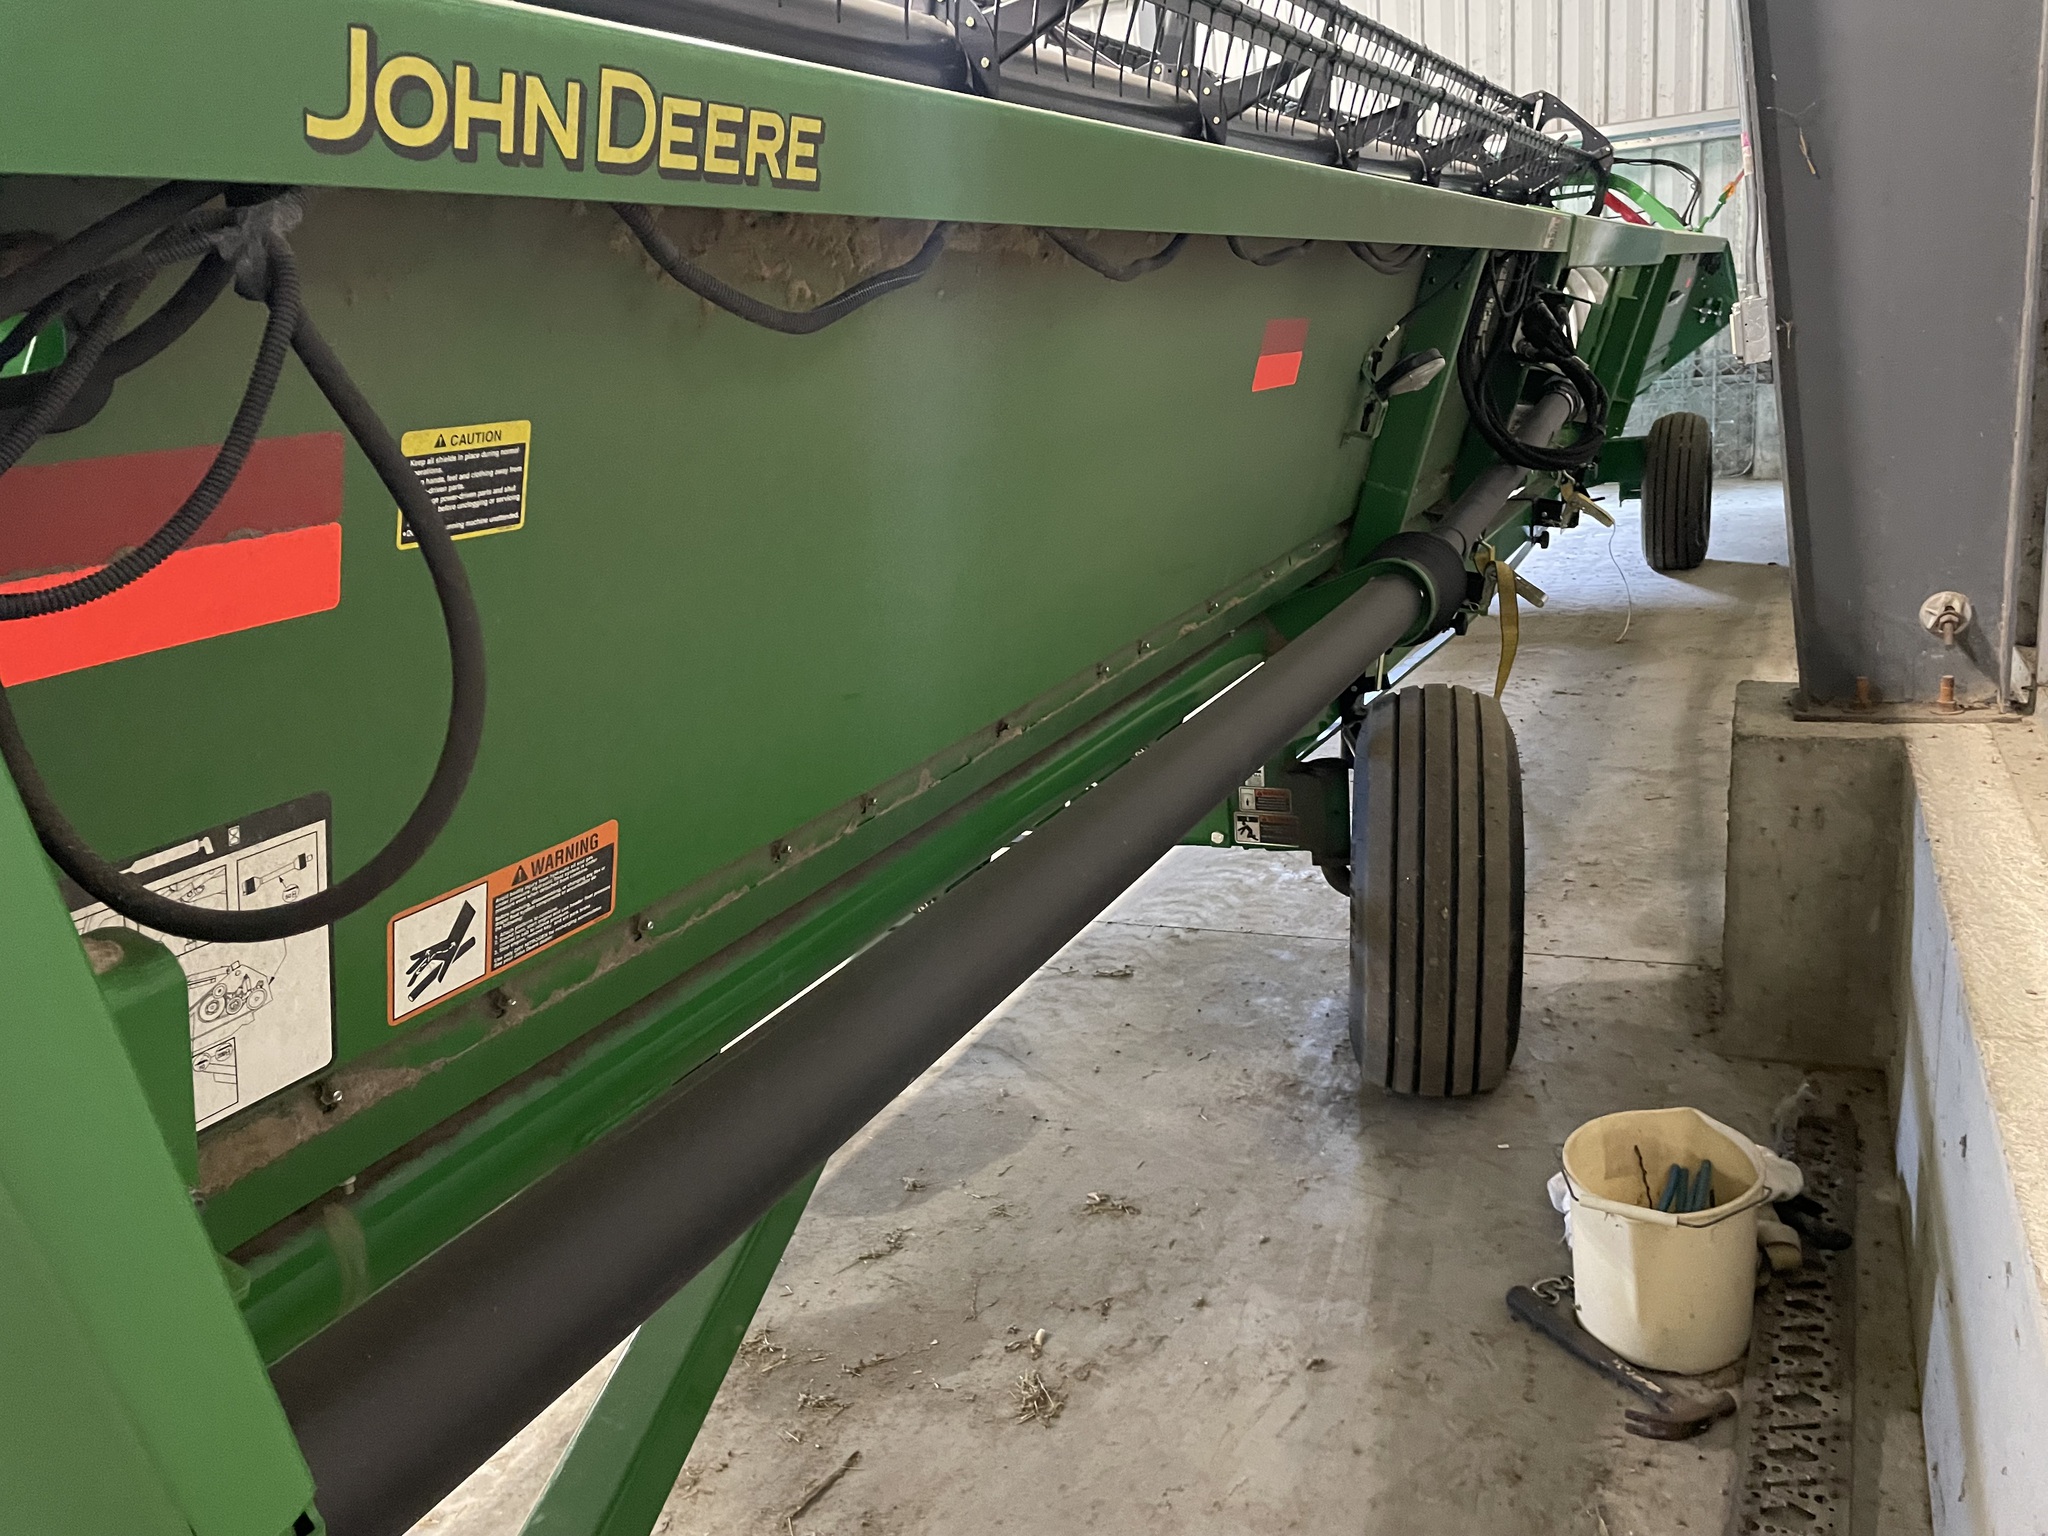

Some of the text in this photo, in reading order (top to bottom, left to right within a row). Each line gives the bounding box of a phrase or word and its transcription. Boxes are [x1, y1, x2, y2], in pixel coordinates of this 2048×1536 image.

[305, 25, 823, 187] JOHN DEERE
[450, 430, 502, 446] CAUTION
[530, 832, 600, 877] WARNING
